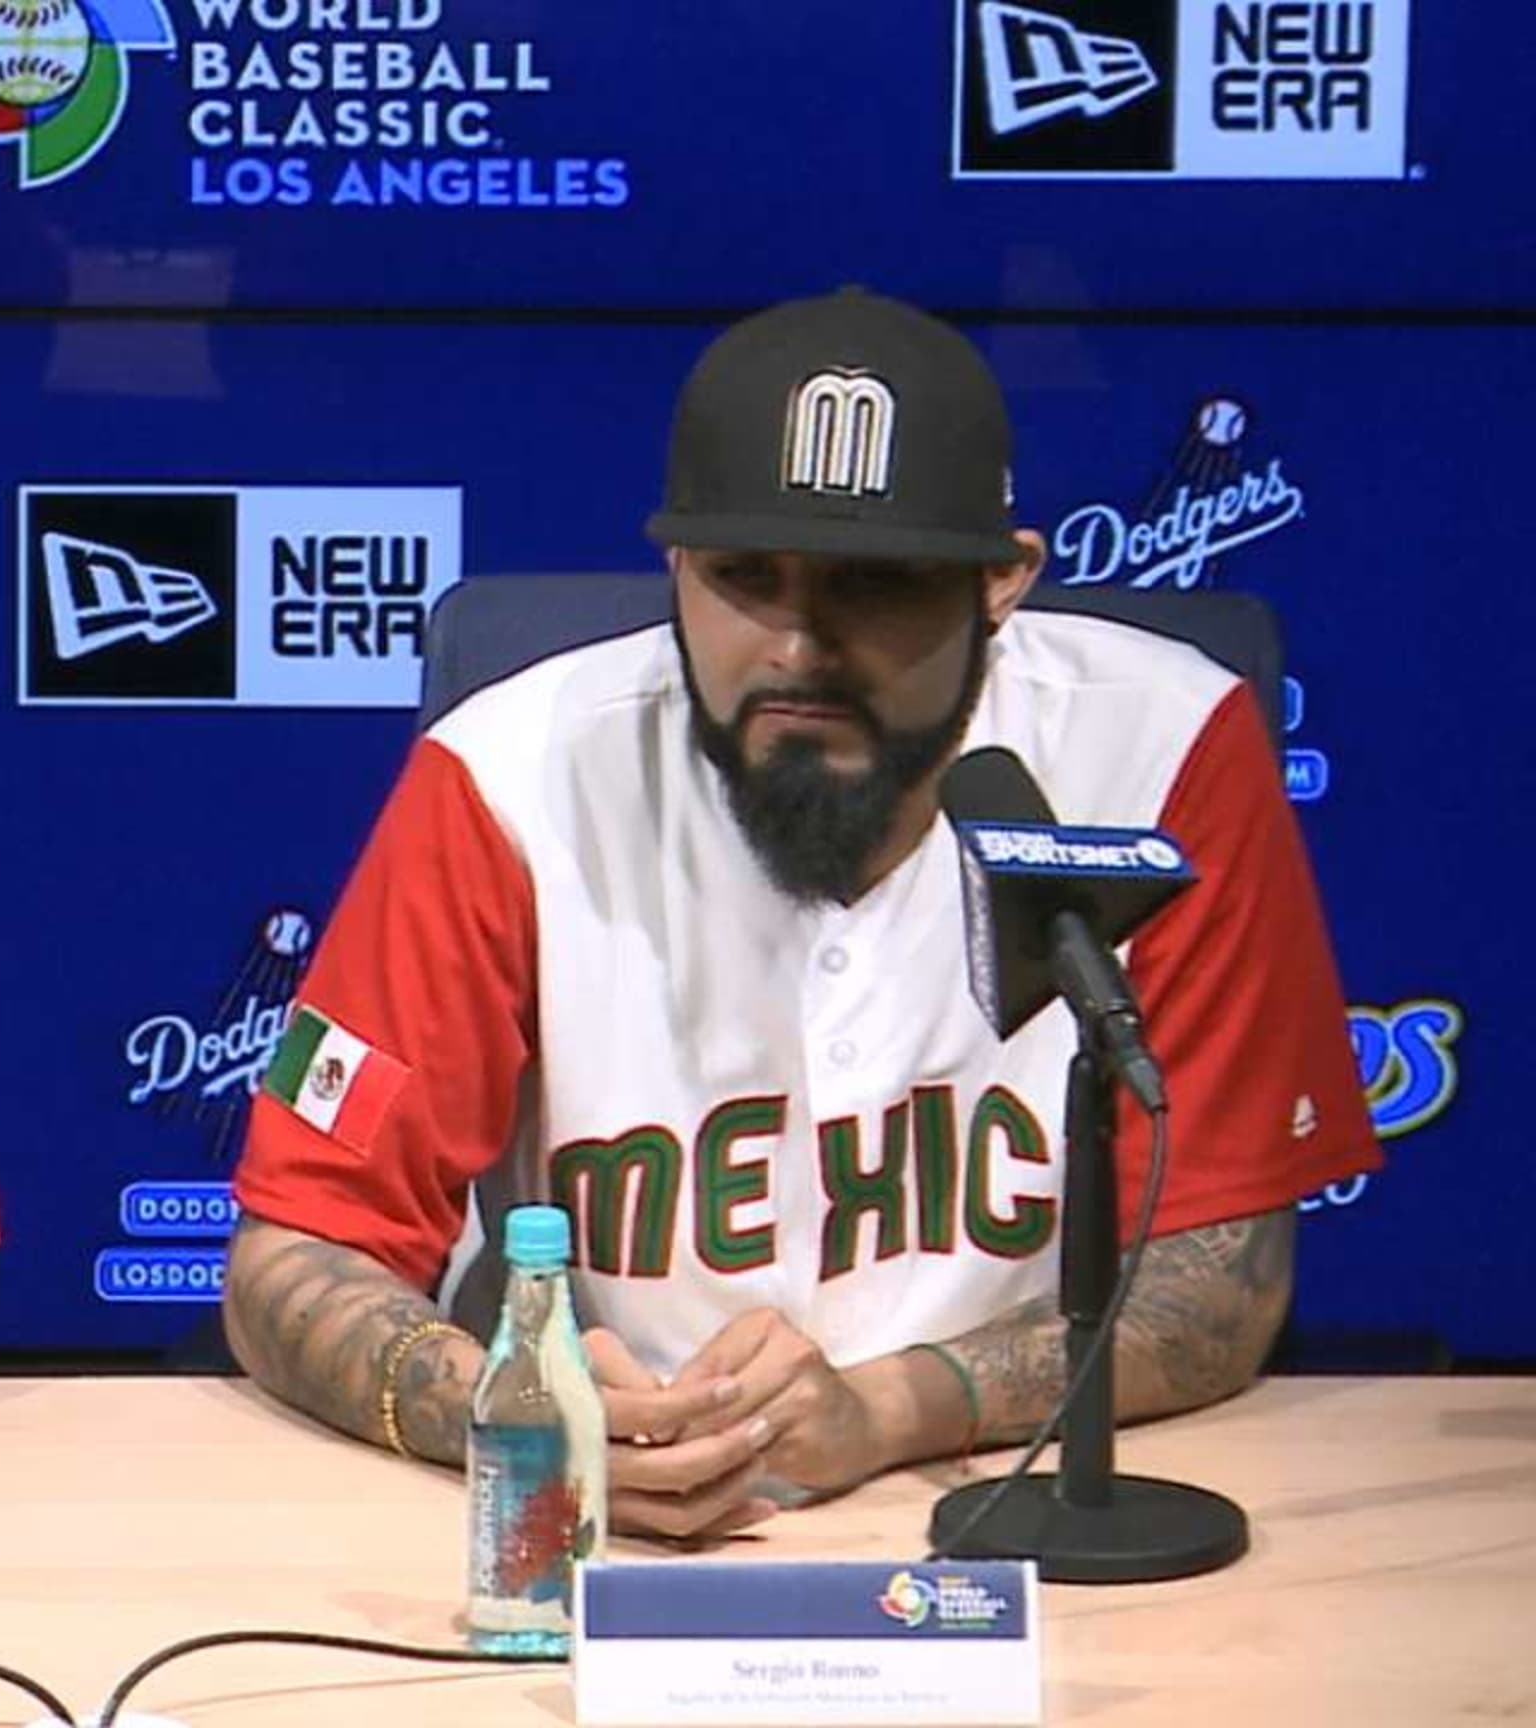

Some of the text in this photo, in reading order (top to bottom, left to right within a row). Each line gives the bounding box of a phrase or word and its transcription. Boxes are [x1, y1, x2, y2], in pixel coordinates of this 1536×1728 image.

[192, 0, 442, 30] WORLD
[1212, 1, 1373, 65] NEW
[191, 42, 551, 91] BASEBALL
[1211, 68, 1371, 131] ERA
[190, 158, 630, 207] LOS ANGELES
[1053, 458, 1304, 589] Dodgers
[270, 534, 428, 597] NEW
[271, 601, 425, 658] ERA
[549, 1083, 1060, 1282] MEXIC
